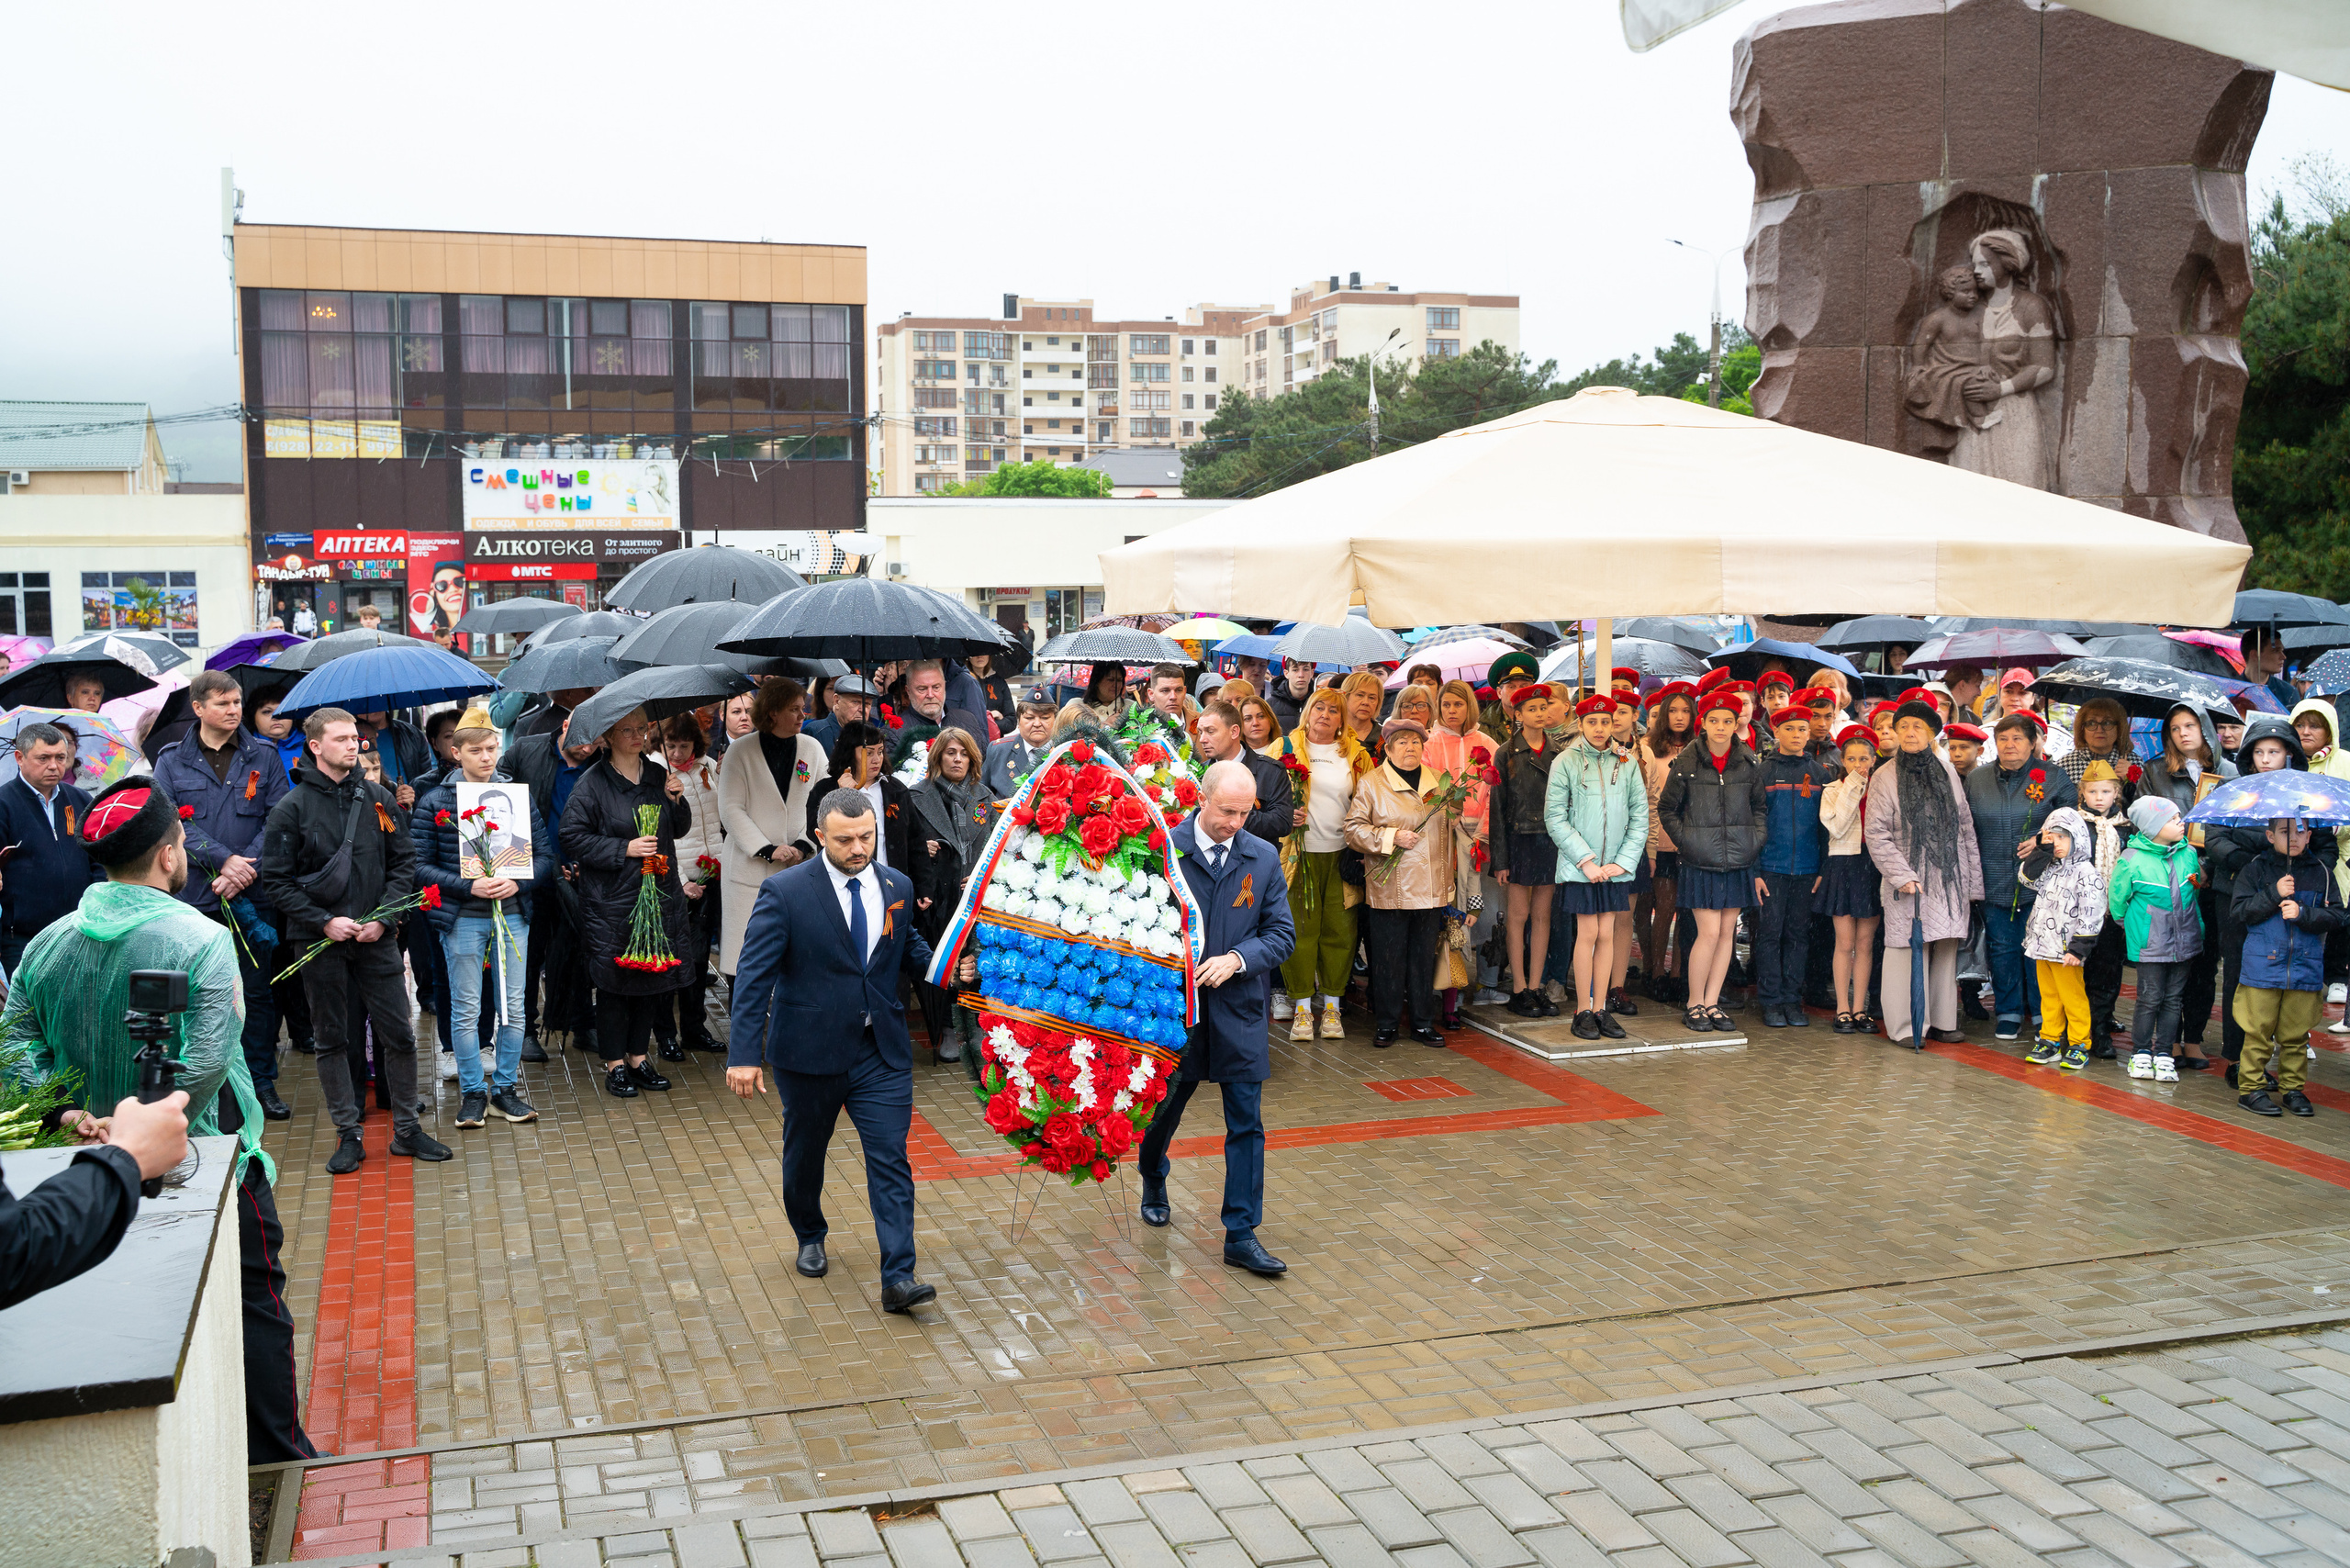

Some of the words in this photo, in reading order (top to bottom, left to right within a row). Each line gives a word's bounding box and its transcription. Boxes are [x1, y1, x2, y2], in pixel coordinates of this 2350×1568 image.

[316, 442, 355, 453] 22-11
[366, 442, 395, 453] 999
[476, 519, 517, 528] ОДЕЖДА
[527, 519, 533, 527] И
[535, 519, 568, 527] ОБУВЬ
[575, 519, 594, 528] ДЛЯ
[597, 518, 621, 527] ВСЕЙ
[632, 519, 664, 527] СЕМЬИ
[320, 536, 405, 553] АПТЕКА
[474, 536, 595, 556] Алкотека
[621, 539, 663, 547] элитного
[605, 548, 617, 556] до
[618, 548, 658, 556] простого
[520, 566, 553, 577] МТС
[995, 587, 1031, 595] ПРОДУКТЫ
